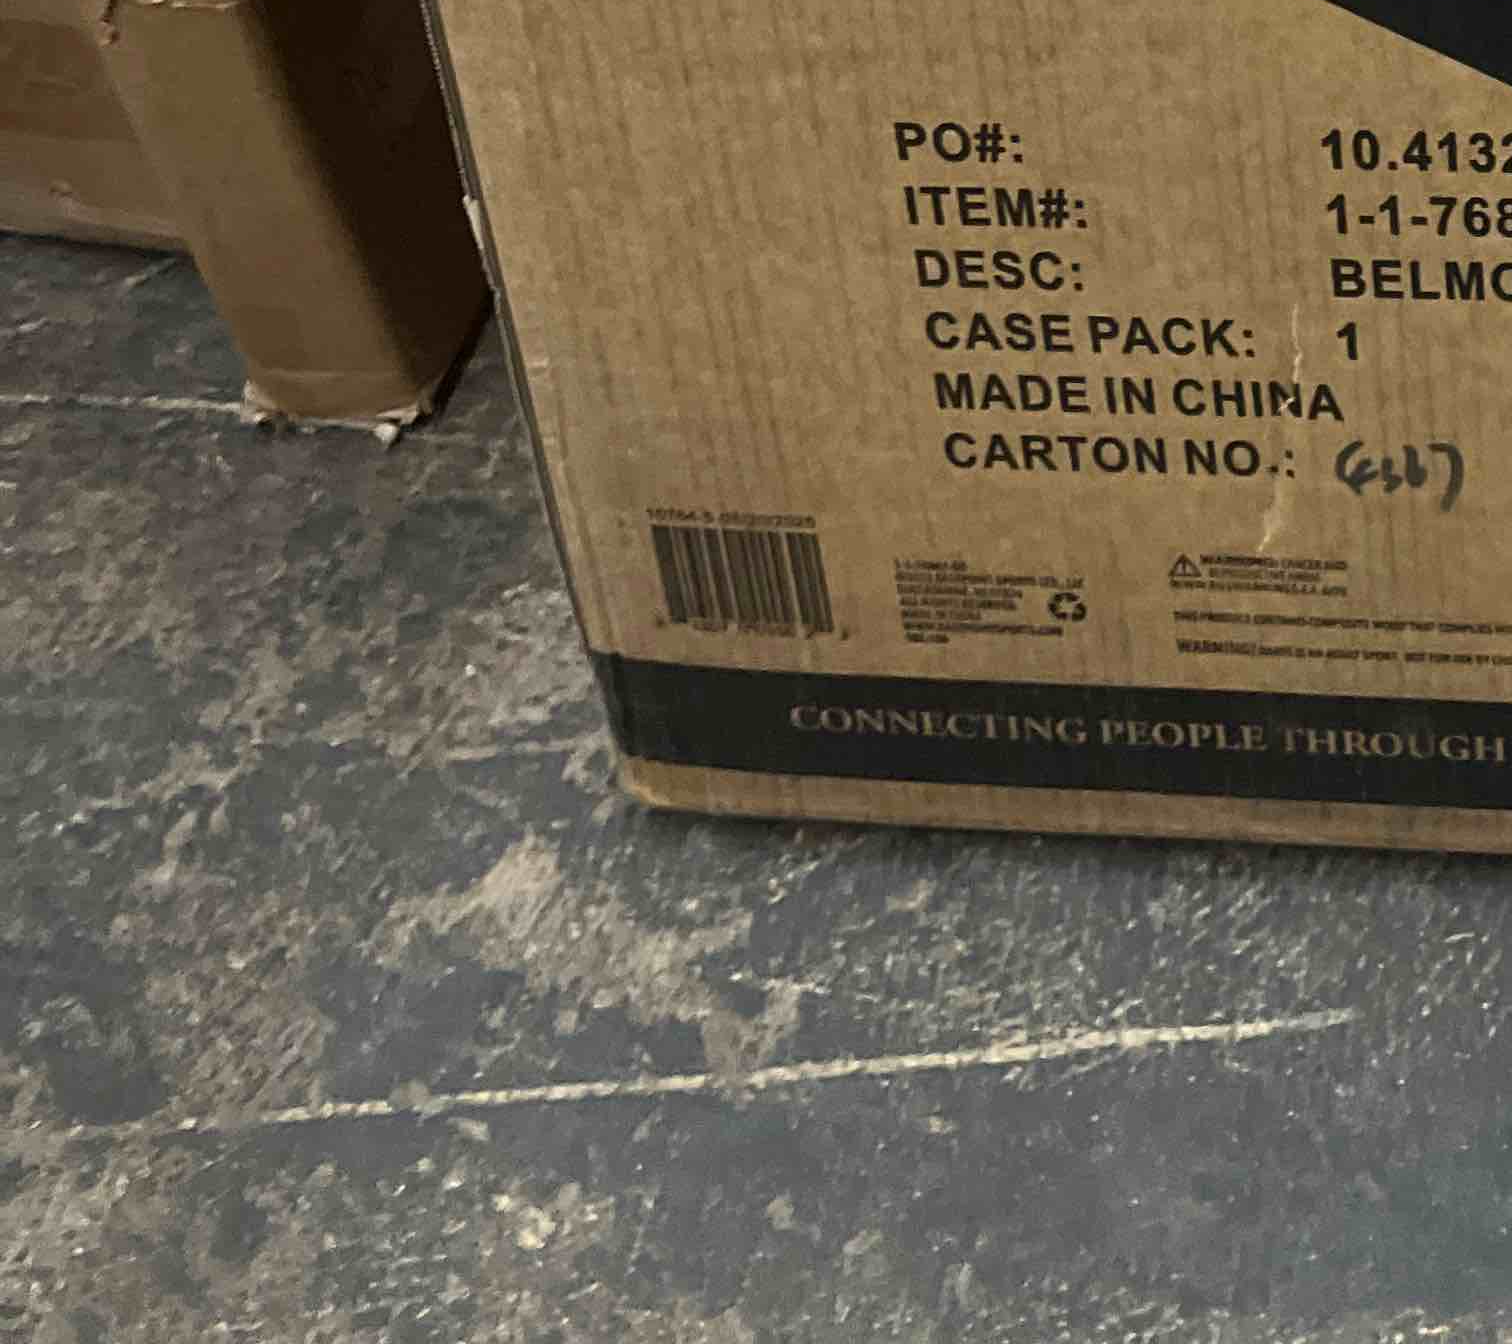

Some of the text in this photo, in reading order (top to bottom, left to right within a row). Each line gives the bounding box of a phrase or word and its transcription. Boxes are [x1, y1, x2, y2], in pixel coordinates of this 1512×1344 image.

[894, 122, 1022, 163] PO#:
[904, 186, 1087, 228] ITEM#:
[915, 250, 1083, 291] DESC:
[926, 312, 1357, 360] CASE PACK: 1
[934, 373, 1344, 421] MADE IN CHINA
[944, 433, 1167, 473] CARTON
[1184, 440, 1294, 478] NO.:
[790, 704, 1087, 746] CONNECTING
[1099, 719, 1267, 753] PEOPLE
[1282, 725, 1505, 763] THROUGH
